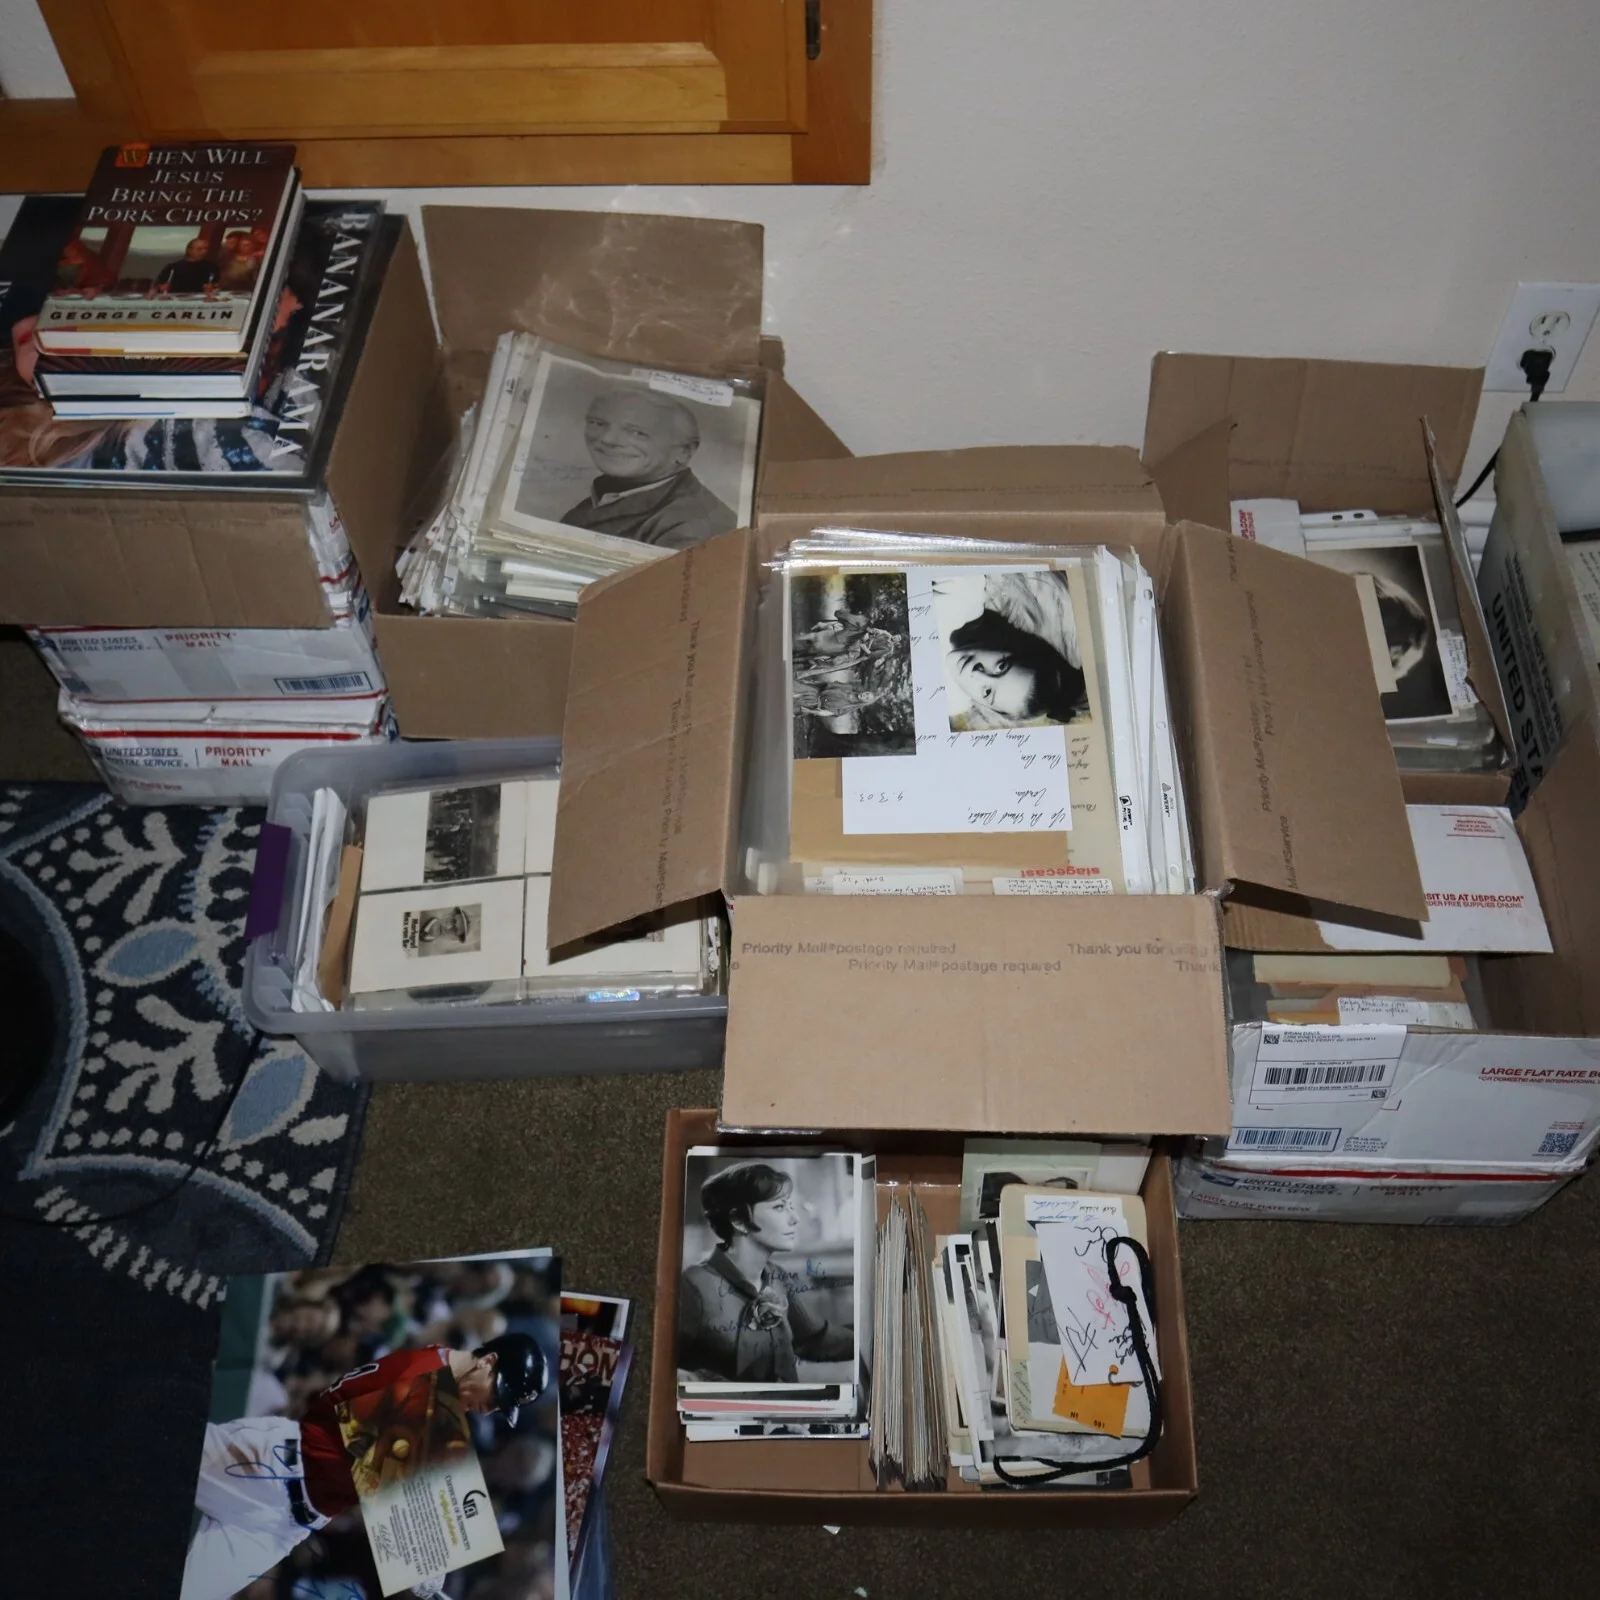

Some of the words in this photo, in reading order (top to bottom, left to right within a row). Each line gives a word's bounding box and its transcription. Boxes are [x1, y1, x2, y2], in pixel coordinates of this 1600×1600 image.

[121, 149, 197, 165] WHEN
[206, 149, 268, 165] WILL
[149, 169, 224, 184] JESUS
[110, 187, 192, 202] BRING
[202, 188, 253, 203] THE
[87, 206, 156, 221] PORK
[165, 207, 262, 222] CHOPS?
[50, 310, 138, 321] GEORGE
[151, 310, 233, 320] CARLIN
[268, 212, 371, 460] BANANARAMA
[185, 640, 221, 648] MAIL
[1492, 593, 1525, 713] UNITED
[105, 748, 143, 757] UNITED
[144, 748, 178, 757] STATES
[221, 759, 252, 767] MAIL
[1020, 866, 1101, 878] stagecast
[1443, 893, 1456, 901] US
[741, 942, 792, 956] Priority
[1067, 943, 1113, 955] Thank
[1115, 945, 1142, 957] you
[1146, 943, 1164, 955] for
[848, 959, 898, 972] Priority
[1481, 1067, 1522, 1076] LARGE
[1524, 1069, 1555, 1077] FLAT
[1556, 1070, 1588, 1078] RATE
